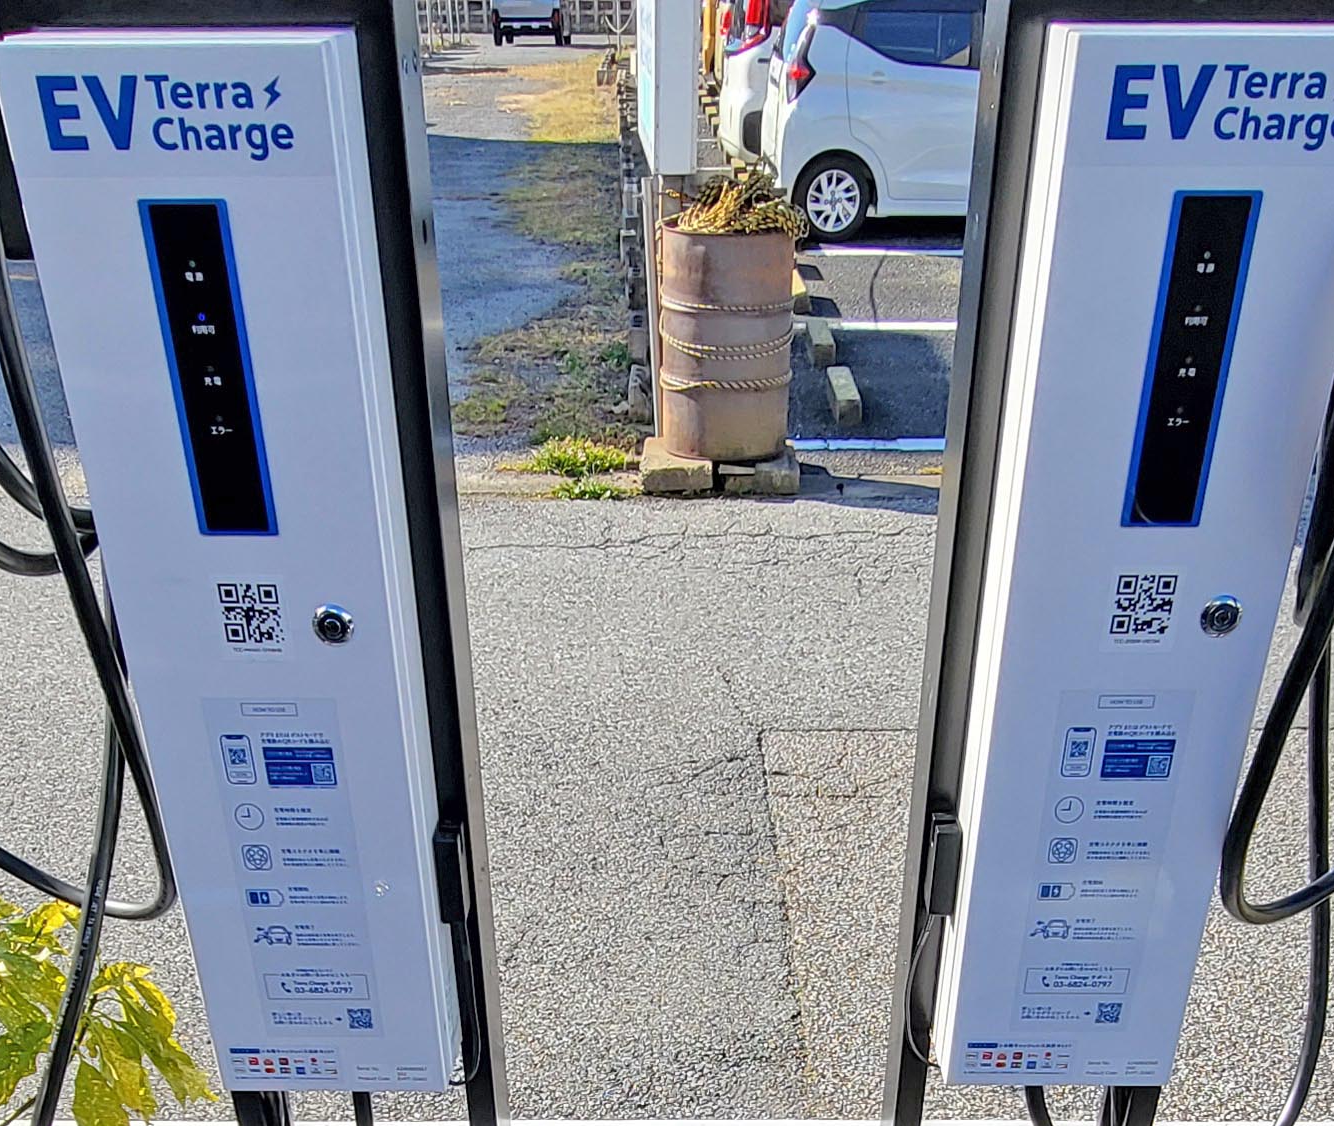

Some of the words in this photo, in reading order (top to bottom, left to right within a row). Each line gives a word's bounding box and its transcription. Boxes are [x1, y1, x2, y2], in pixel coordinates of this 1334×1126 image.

[35, 75, 138, 151] EV
[144, 74, 254, 110] Terra
[1105, 64, 1218, 141] EV
[1224, 64, 1328, 99] Terra
[152, 117, 294, 161] Charge
[210, 425, 233, 434] エラー
[1167, 417, 1190, 426] エラー
